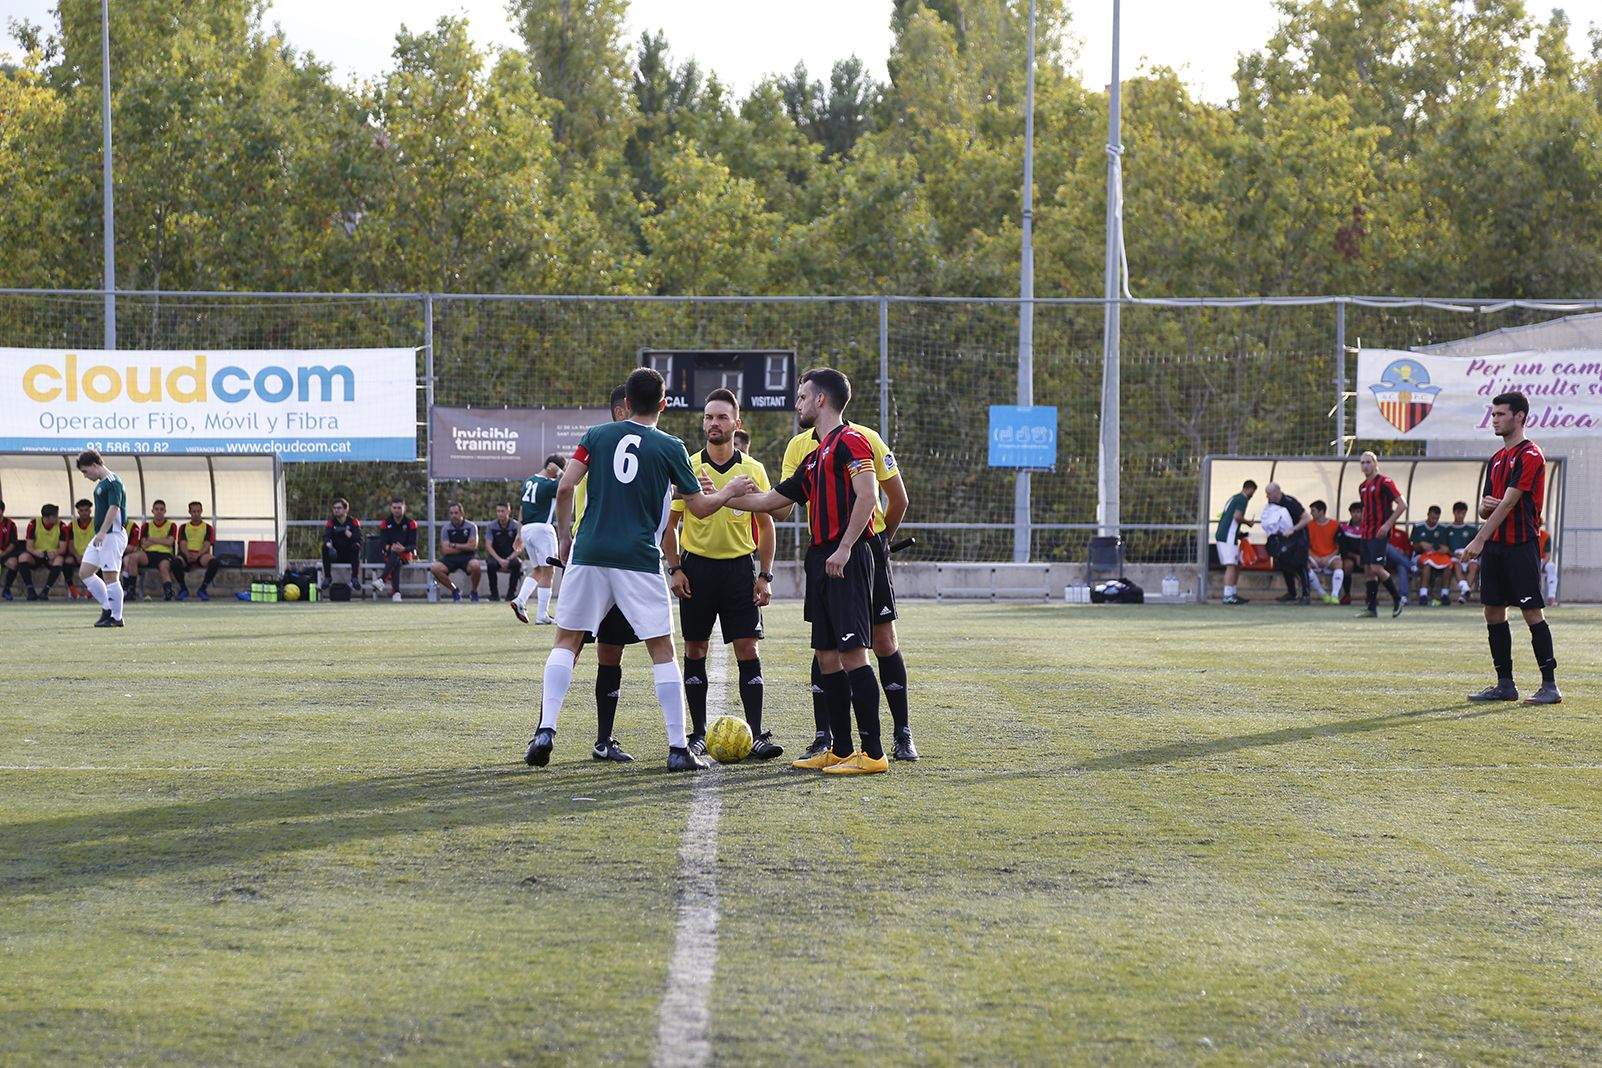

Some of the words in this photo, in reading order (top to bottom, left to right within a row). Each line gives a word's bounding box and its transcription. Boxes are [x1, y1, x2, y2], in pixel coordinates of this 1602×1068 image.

[23, 354, 355, 403] cloudcom
[1466, 359, 1505, 376] Per
[1513, 362, 1545, 375] un
[1552, 361, 1602, 381] cam
[1477, 377, 1580, 395] d'insults
[664, 396, 689, 408] CAL
[751, 396, 786, 407] VISITANT
[39, 412, 140, 433] Operador
[148, 412, 196, 433] Fijo,
[205, 411, 258, 430] Móvil
[267, 417, 278, 433] y
[286, 412, 339, 430] Fibra
[1476, 404, 1599, 429] Ilica
[453, 427, 519, 438] Invisible
[109, 442, 130, 452] 586
[134, 442, 149, 452] 30
[153, 442, 169, 452] 82
[226, 440, 351, 453] www.cloudcom.cat
[455, 437, 516, 454] training
[613, 434, 642, 484] 6
[522, 480, 539, 503] 21
